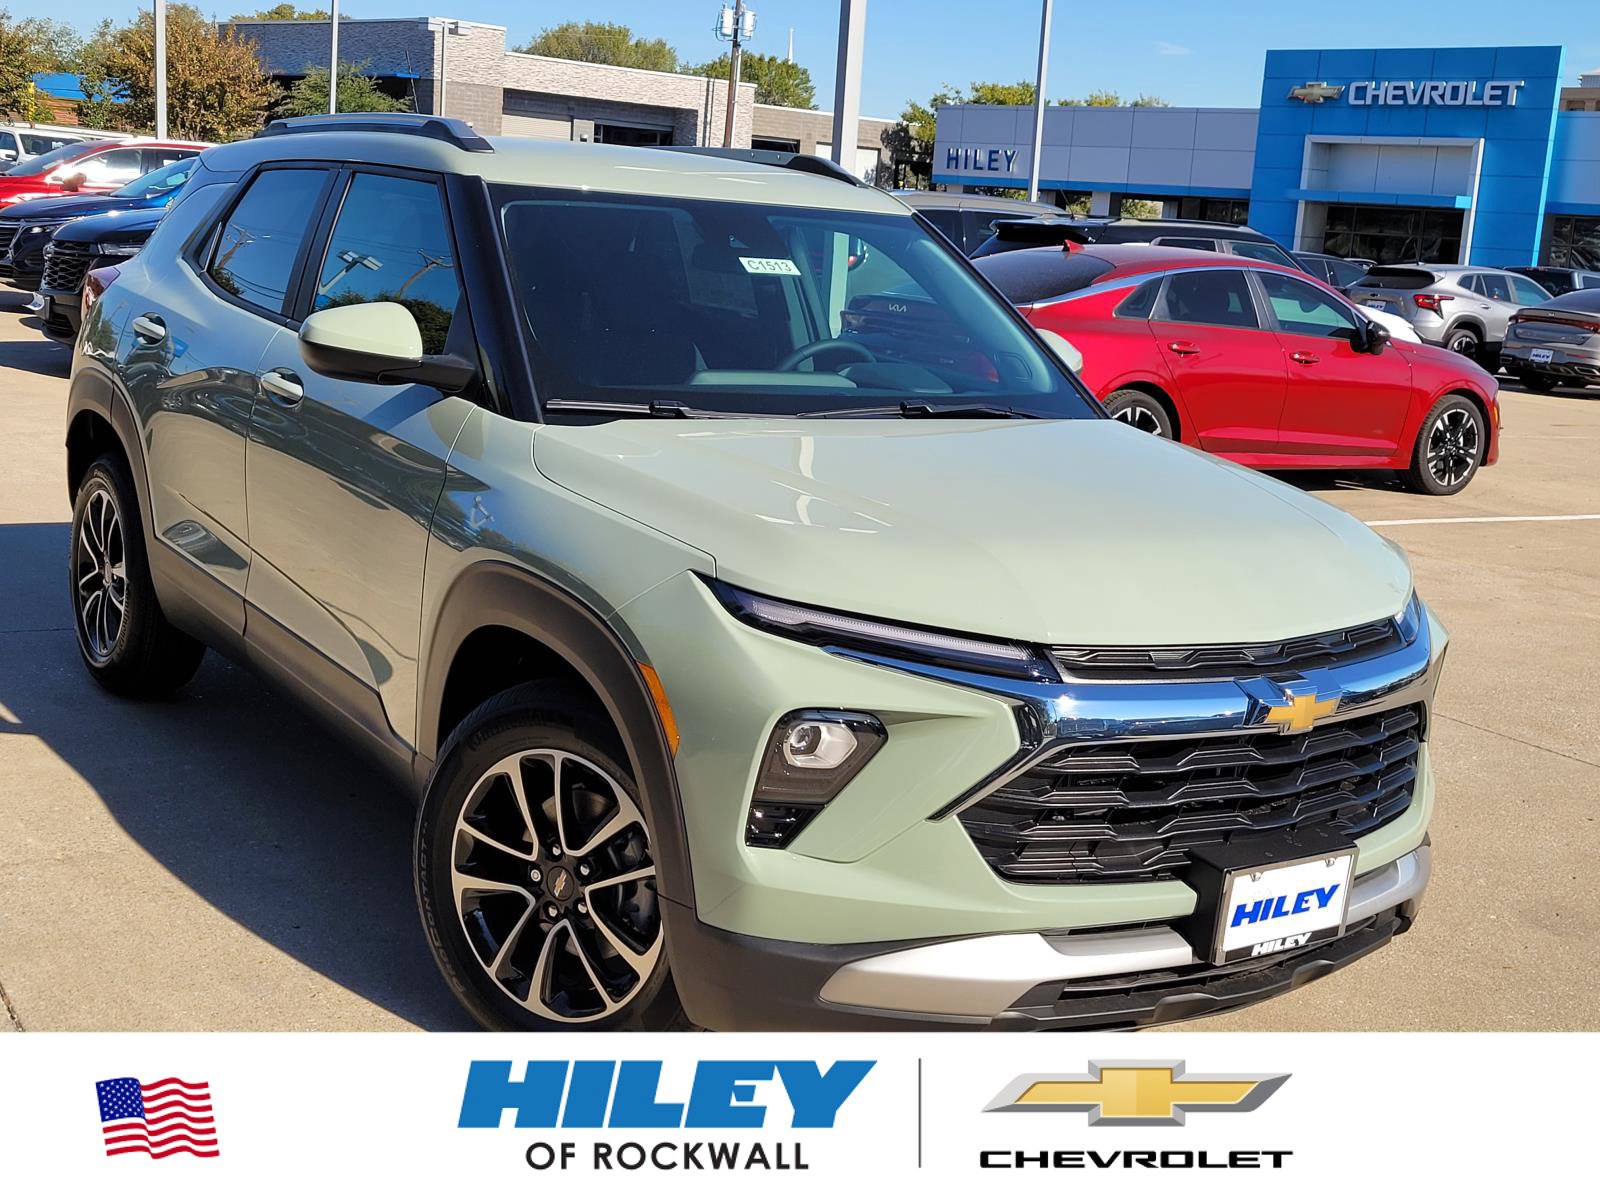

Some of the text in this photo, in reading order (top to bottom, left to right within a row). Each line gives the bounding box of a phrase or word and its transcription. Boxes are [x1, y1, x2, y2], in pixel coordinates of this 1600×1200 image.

[1348, 80, 1525, 106] CHEVROLET
[946, 148, 1018, 172] HILEY
[747, 259, 792, 272] C1513
[1230, 883, 1341, 928] HILEY
[1251, 932, 1313, 957] HILEY
